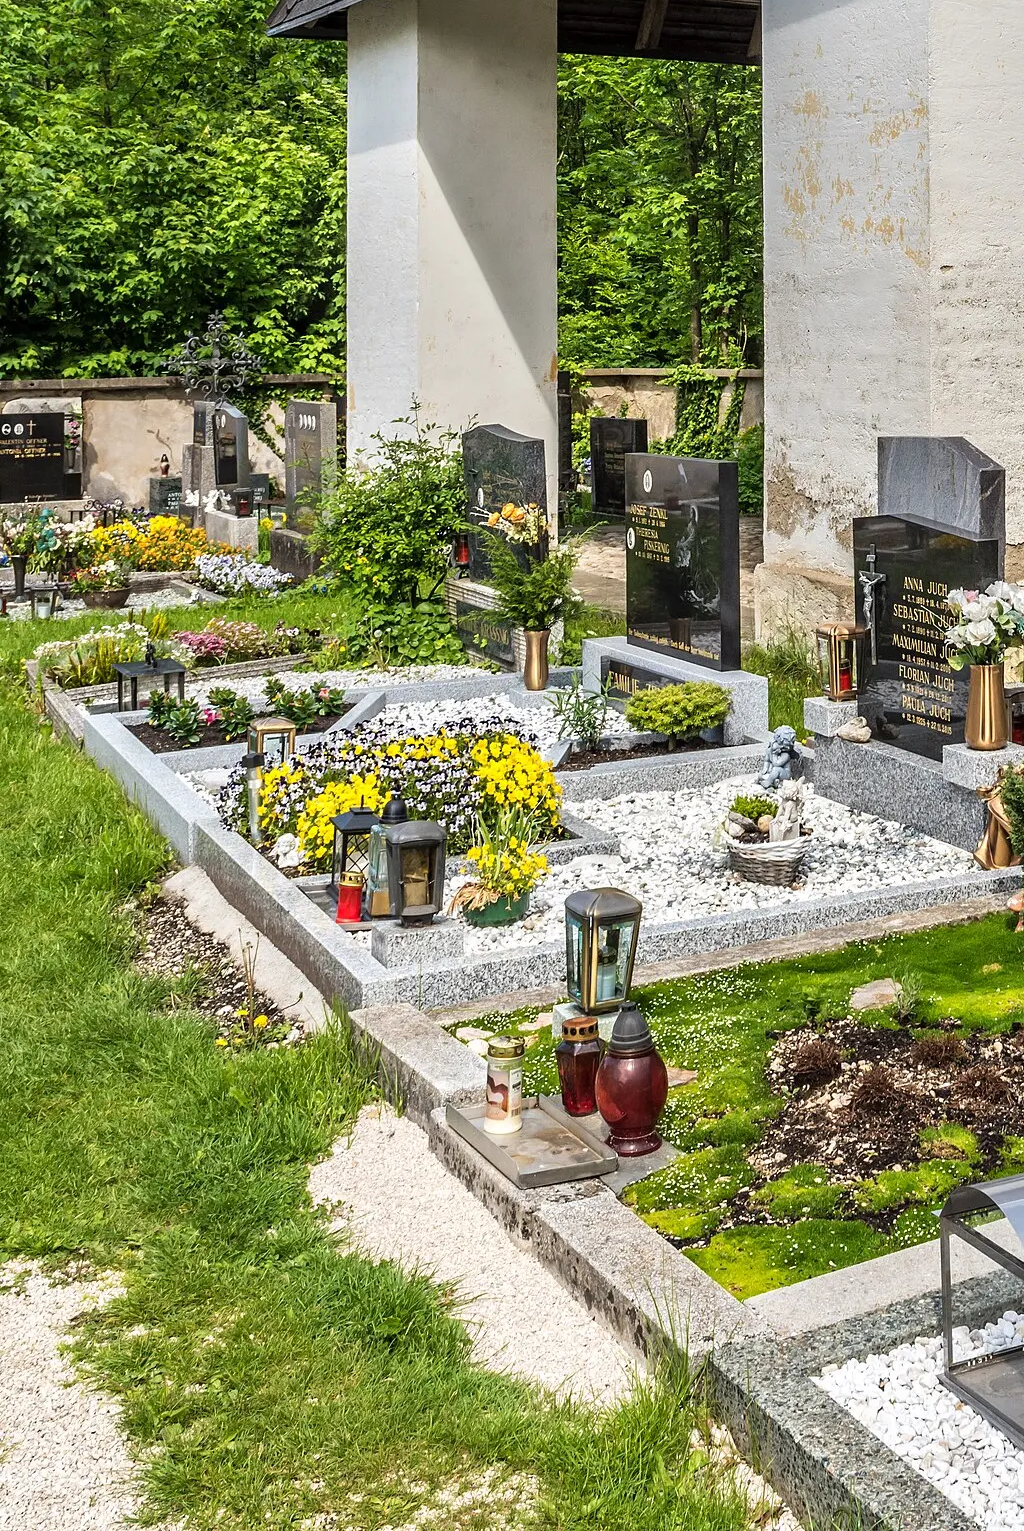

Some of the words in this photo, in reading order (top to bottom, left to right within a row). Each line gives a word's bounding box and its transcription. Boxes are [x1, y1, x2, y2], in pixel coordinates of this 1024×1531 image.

[903, 576, 924, 593] ANNA
[927, 581, 948, 597] JUCH
[893, 603, 935, 625] SEBASTIAN
[892, 633, 937, 657] MAXIMILIAN
[899, 664, 930, 685] FLORIAN
[932, 674, 955, 692] JUCH
[902, 694, 926, 714] PAULA
[929, 704, 951, 722] JUCH
